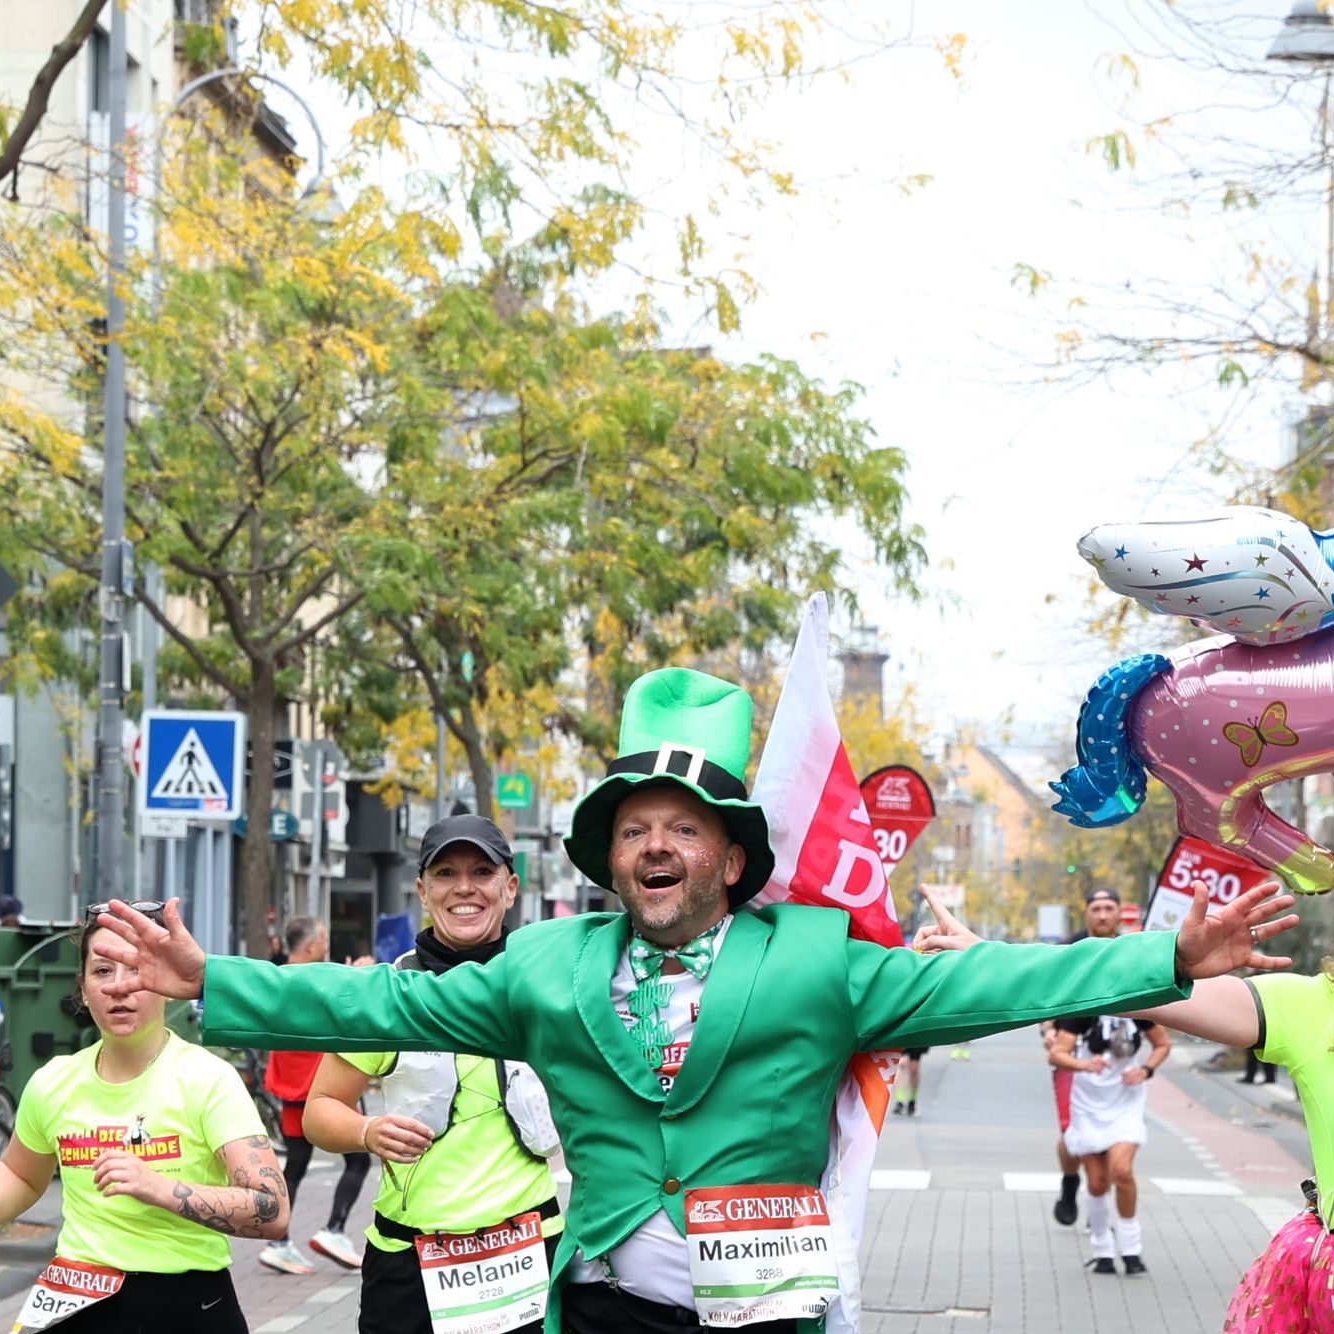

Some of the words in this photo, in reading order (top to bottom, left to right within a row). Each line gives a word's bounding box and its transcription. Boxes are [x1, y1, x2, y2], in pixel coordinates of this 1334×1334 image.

[1169, 857, 1241, 904] 5:30
[99, 1129, 125, 1142] DIE
[725, 1195, 825, 1221] GENERALI
[698, 1235, 828, 1262] Maximilian
[47, 1264, 120, 1293] GENERALI
[437, 1254, 534, 1291] Melanie
[755, 1267, 784, 1280] 3288
[478, 1285, 505, 1300] 2728
